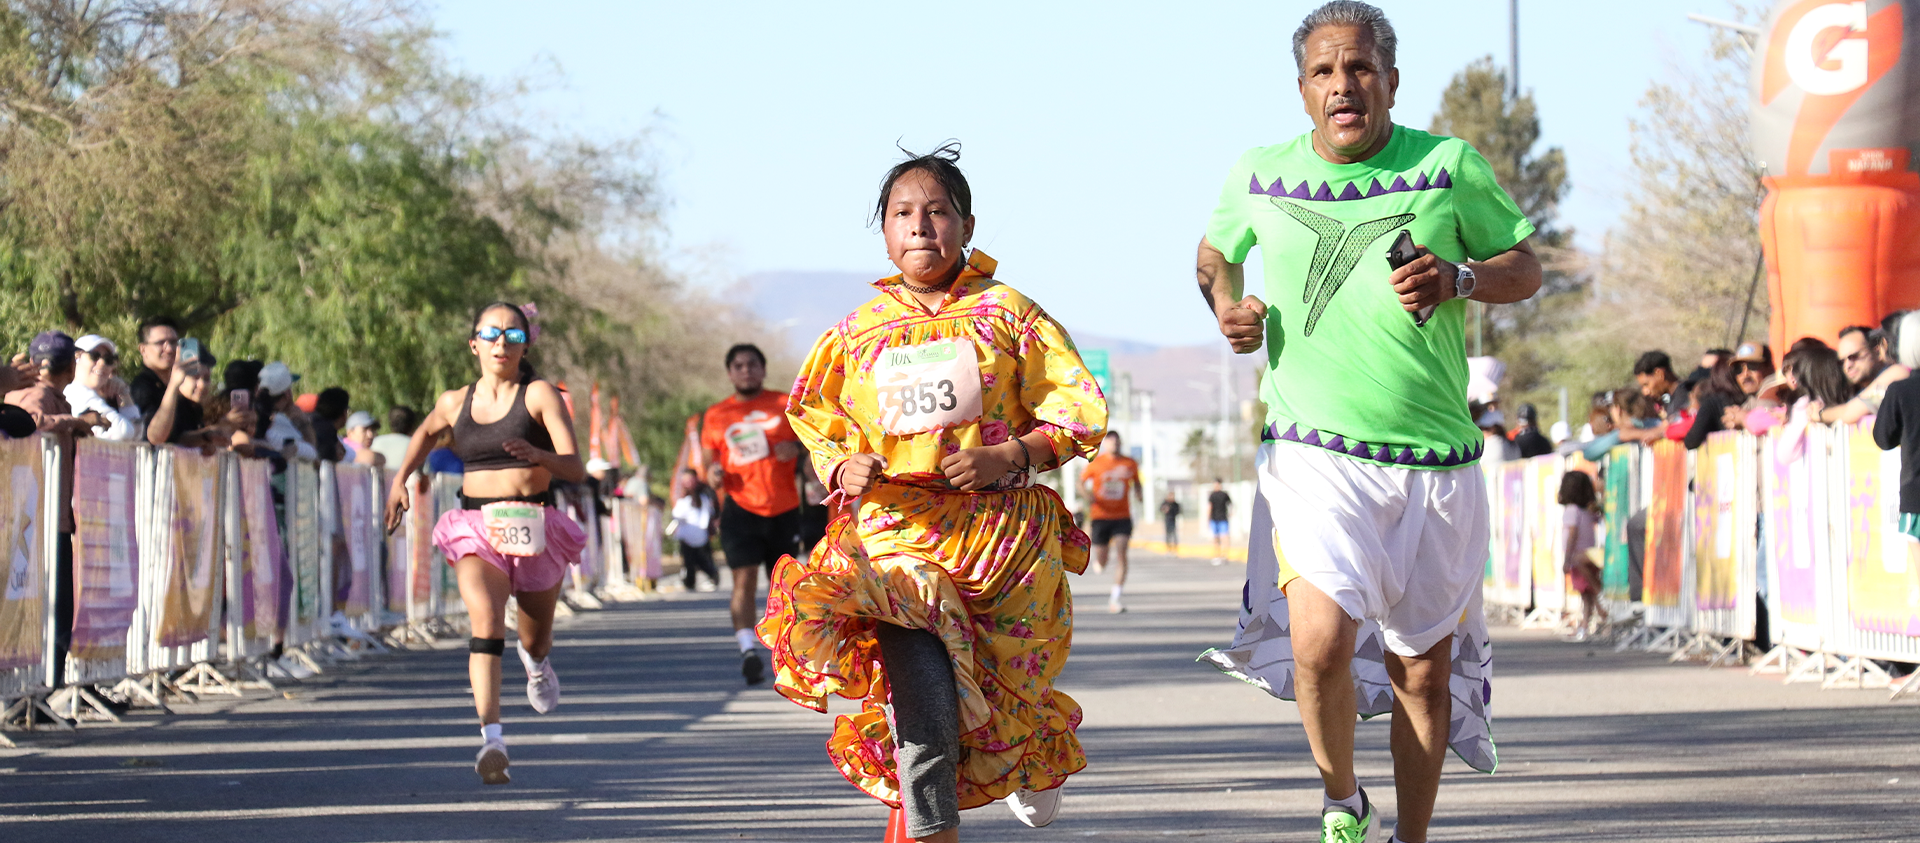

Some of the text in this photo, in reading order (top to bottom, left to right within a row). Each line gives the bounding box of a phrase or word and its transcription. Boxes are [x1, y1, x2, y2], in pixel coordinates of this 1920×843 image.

[1785, 1, 1868, 96] G
[890, 352, 912, 367] 10K
[900, 379, 957, 417] 853
[498, 526, 532, 545] 383
